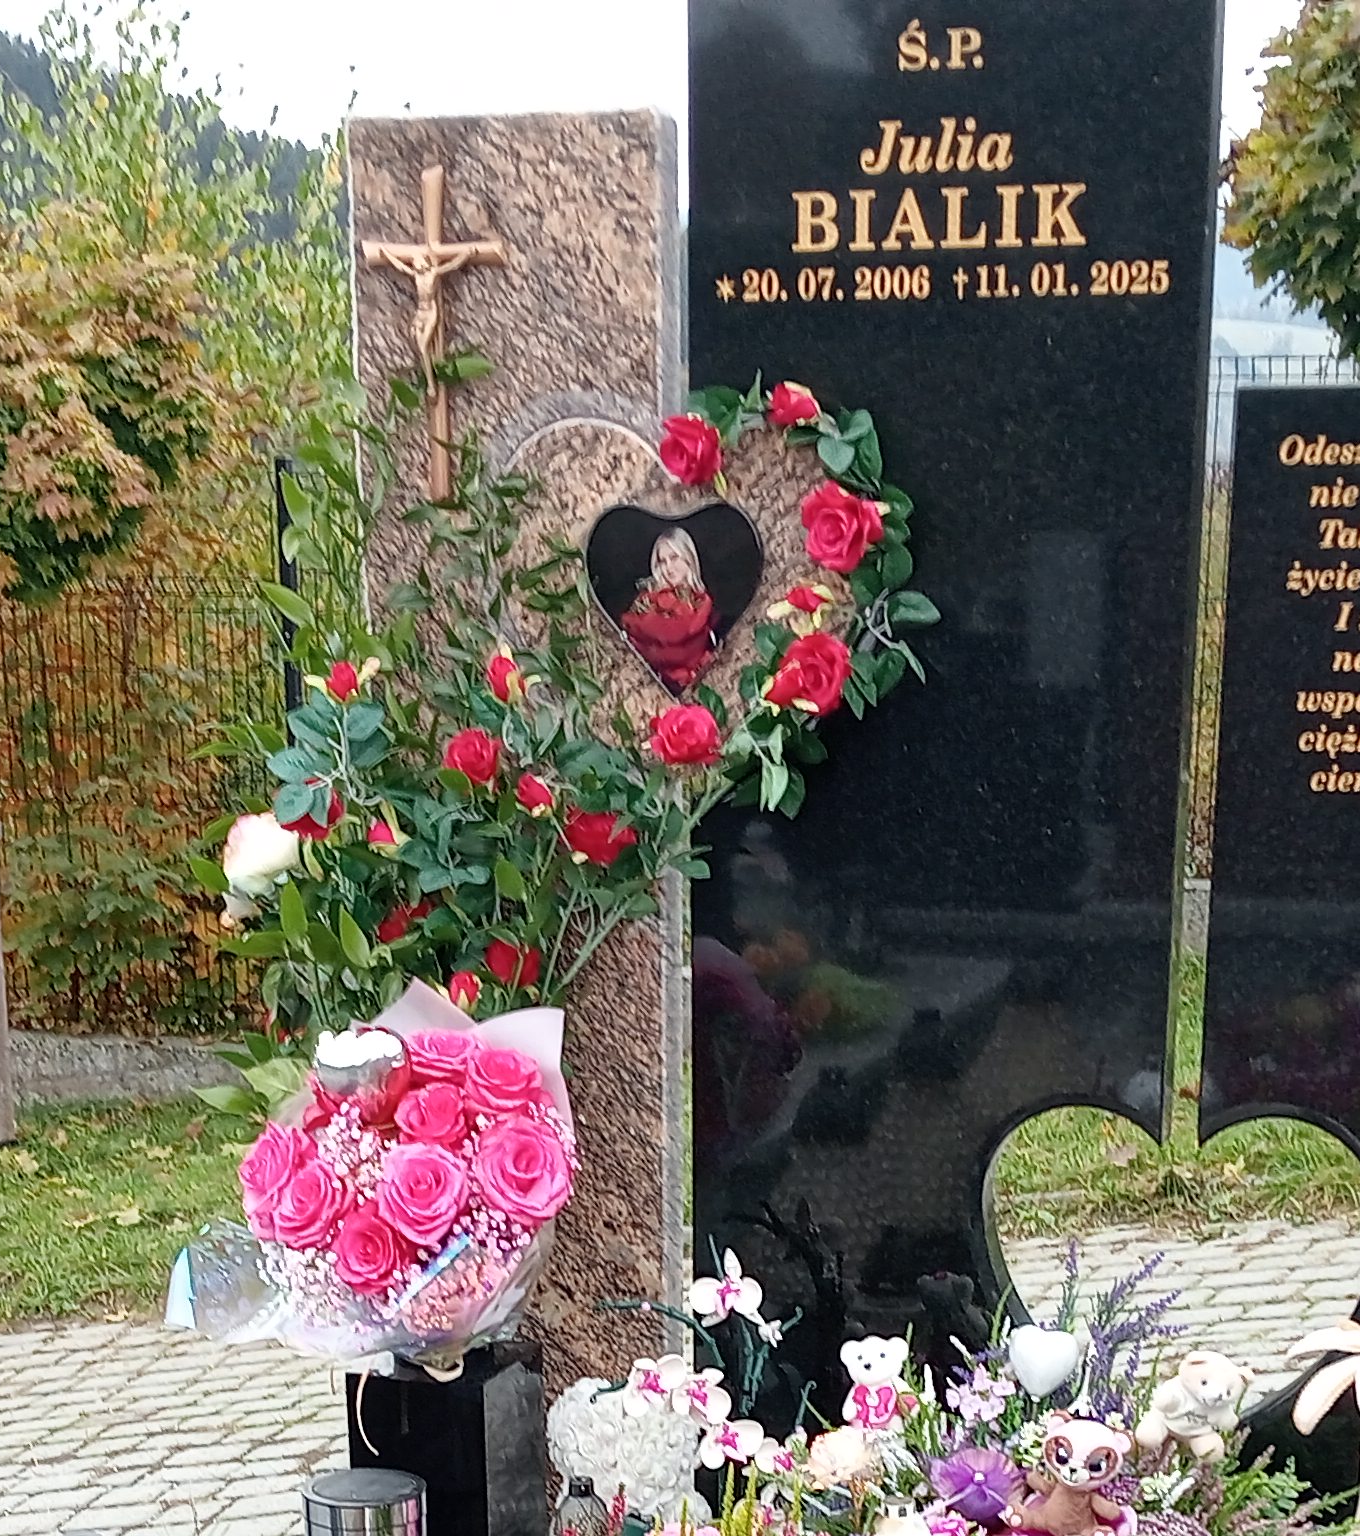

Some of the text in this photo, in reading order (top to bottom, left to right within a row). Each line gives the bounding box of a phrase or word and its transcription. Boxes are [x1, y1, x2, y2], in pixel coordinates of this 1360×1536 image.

[859, 116, 1015, 176] Julia
[791, 182, 1088, 254] BIALIK
[1309, 476, 1360, 508] nie
[1332, 601, 1355, 632] I
